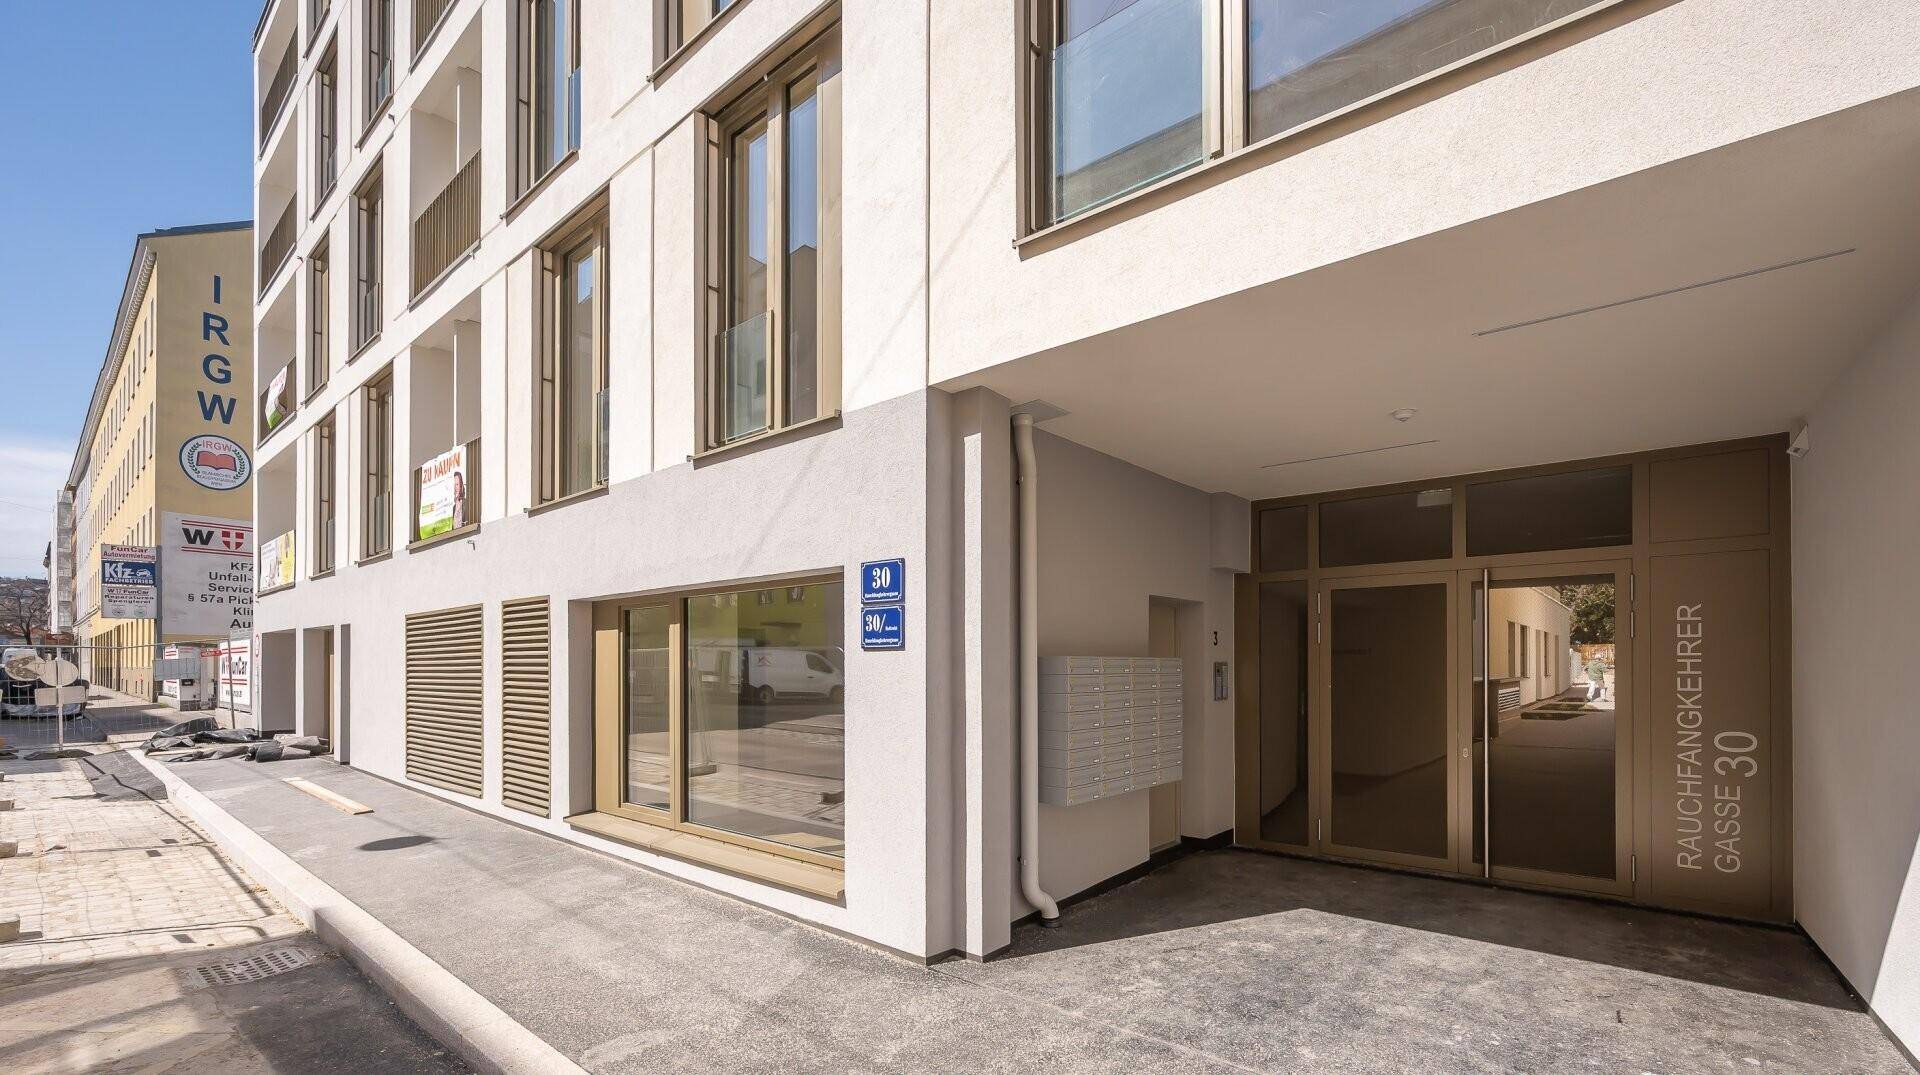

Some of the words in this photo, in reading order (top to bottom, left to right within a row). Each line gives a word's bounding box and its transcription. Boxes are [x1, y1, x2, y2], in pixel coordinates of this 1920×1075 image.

[197, 275, 237, 425] IRGW
[202, 440, 232, 451] IRGW
[182, 528, 215, 545] W
[104, 551, 155, 559] Autovermietung
[111, 545, 148, 553] FunCar
[104, 563, 134, 578] Kfz
[209, 572, 253, 582] Unfall-
[872, 566, 891, 589] 30
[188, 593, 194, 601] §
[200, 594, 223, 603] 57a
[234, 607, 253, 615] Kli
[230, 619, 253, 628] Au
[1213, 631, 1218, 646] 3
[1676, 603, 1702, 870] RAUCHFANGKEHRER
[1713, 731, 1758, 778] 30
[1714, 785, 1741, 873] GASSE
